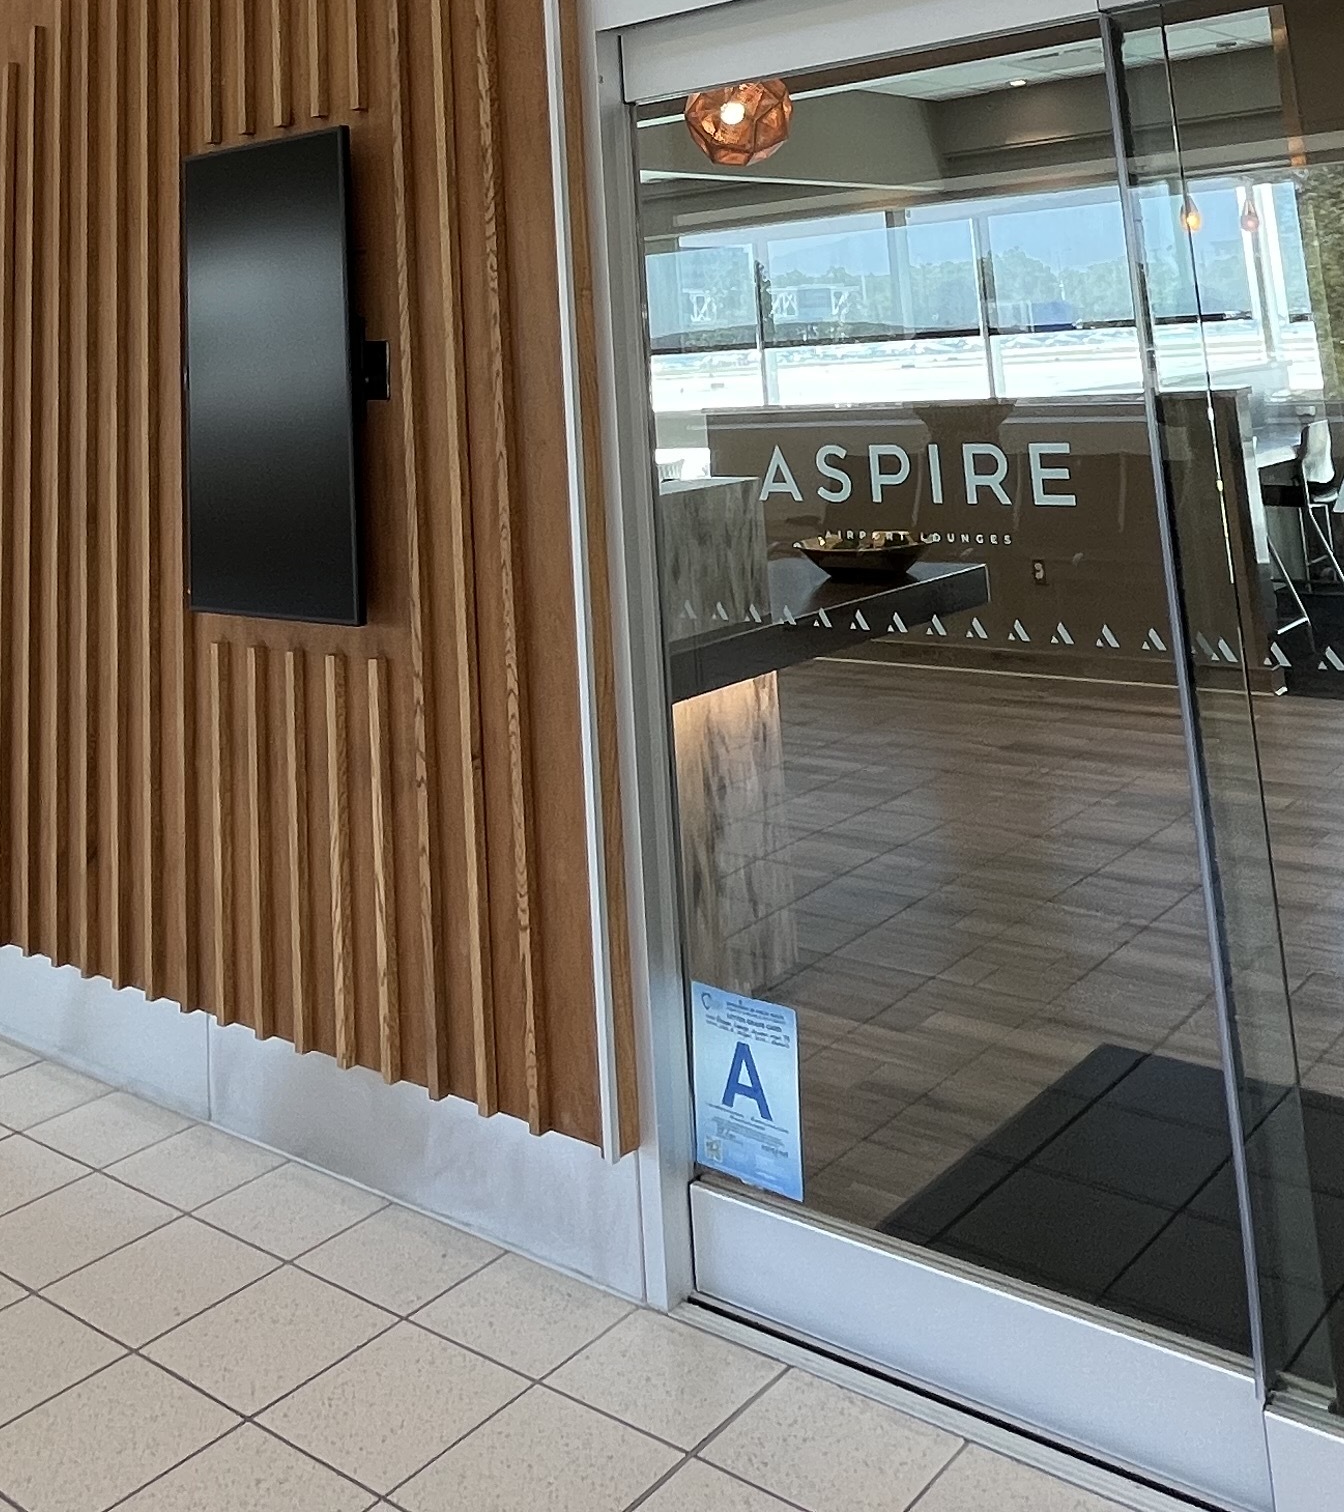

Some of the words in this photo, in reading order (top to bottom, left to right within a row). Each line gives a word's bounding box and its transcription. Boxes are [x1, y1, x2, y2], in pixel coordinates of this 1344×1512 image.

[759, 441, 1078, 508] ASPIRE
[919, 531, 1013, 546] LOUNGES
[722, 1041, 773, 1122] A
